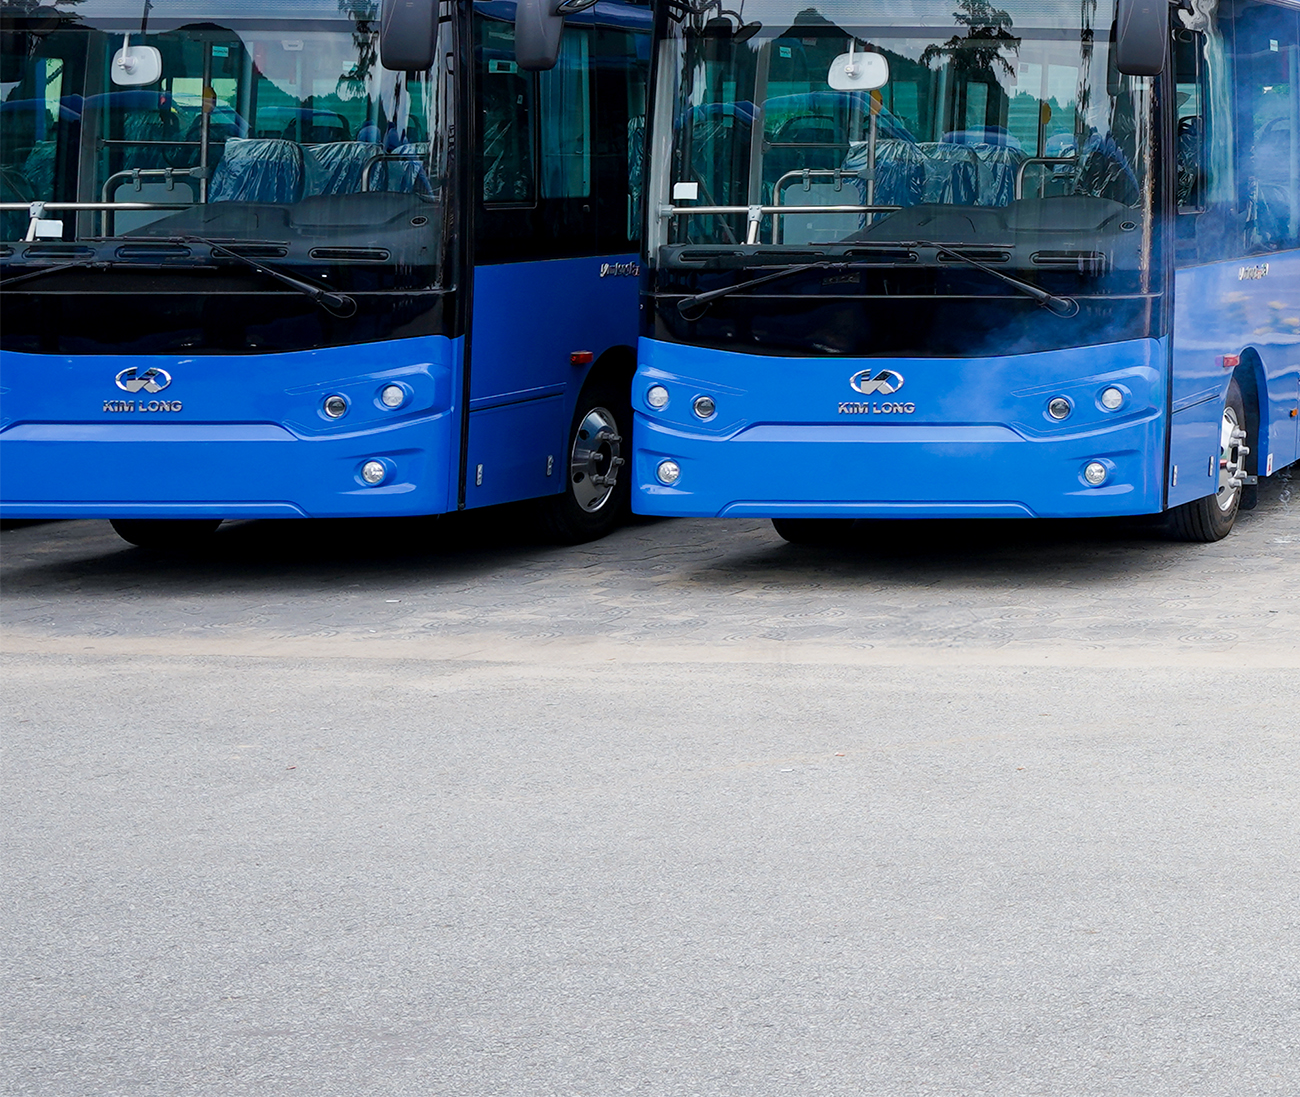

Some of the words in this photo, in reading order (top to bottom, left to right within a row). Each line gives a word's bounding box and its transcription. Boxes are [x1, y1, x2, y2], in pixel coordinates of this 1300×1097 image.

[103, 400, 135, 412] KIM
[139, 400, 182, 412] LONG
[838, 402, 869, 414] KIM
[873, 402, 916, 414] LONG
